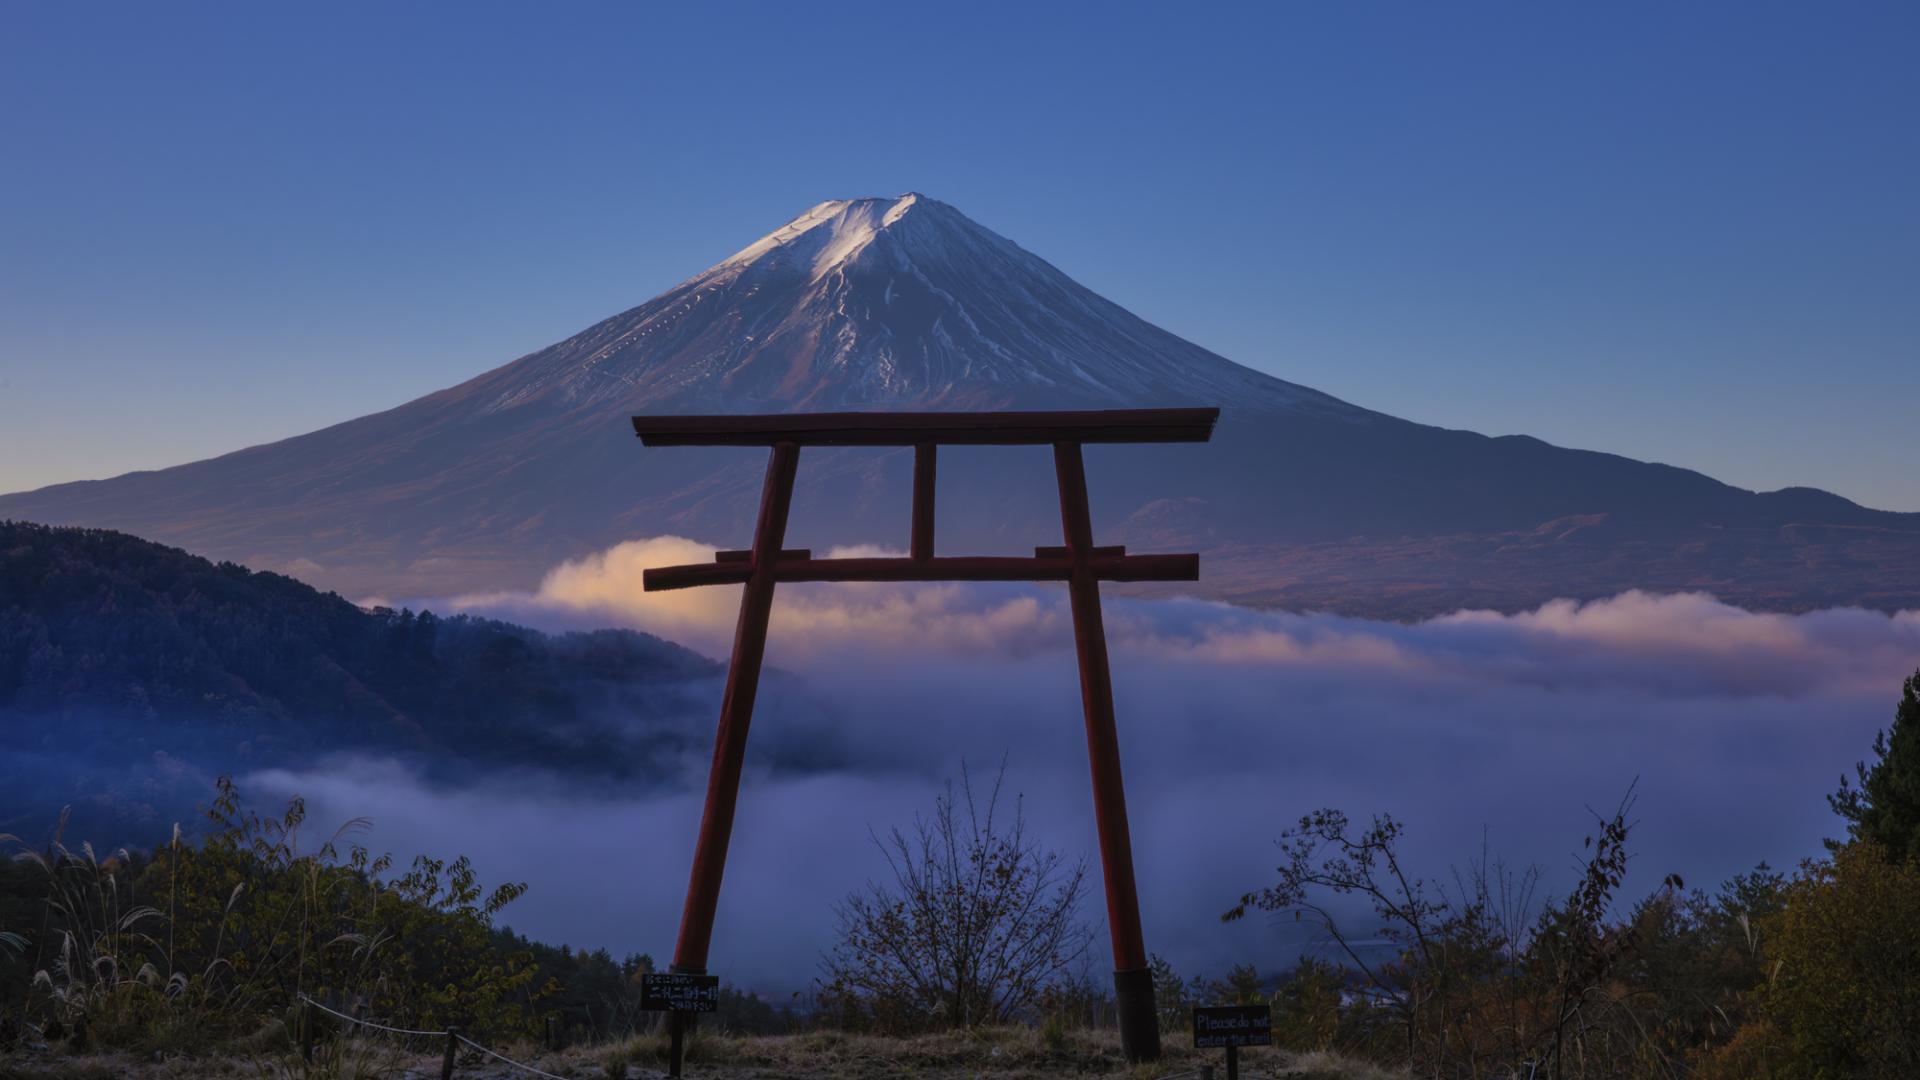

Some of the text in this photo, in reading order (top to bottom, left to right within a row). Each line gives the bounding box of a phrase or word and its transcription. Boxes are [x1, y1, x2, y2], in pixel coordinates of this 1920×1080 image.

[1197, 1013, 1271, 1030] Please do not
